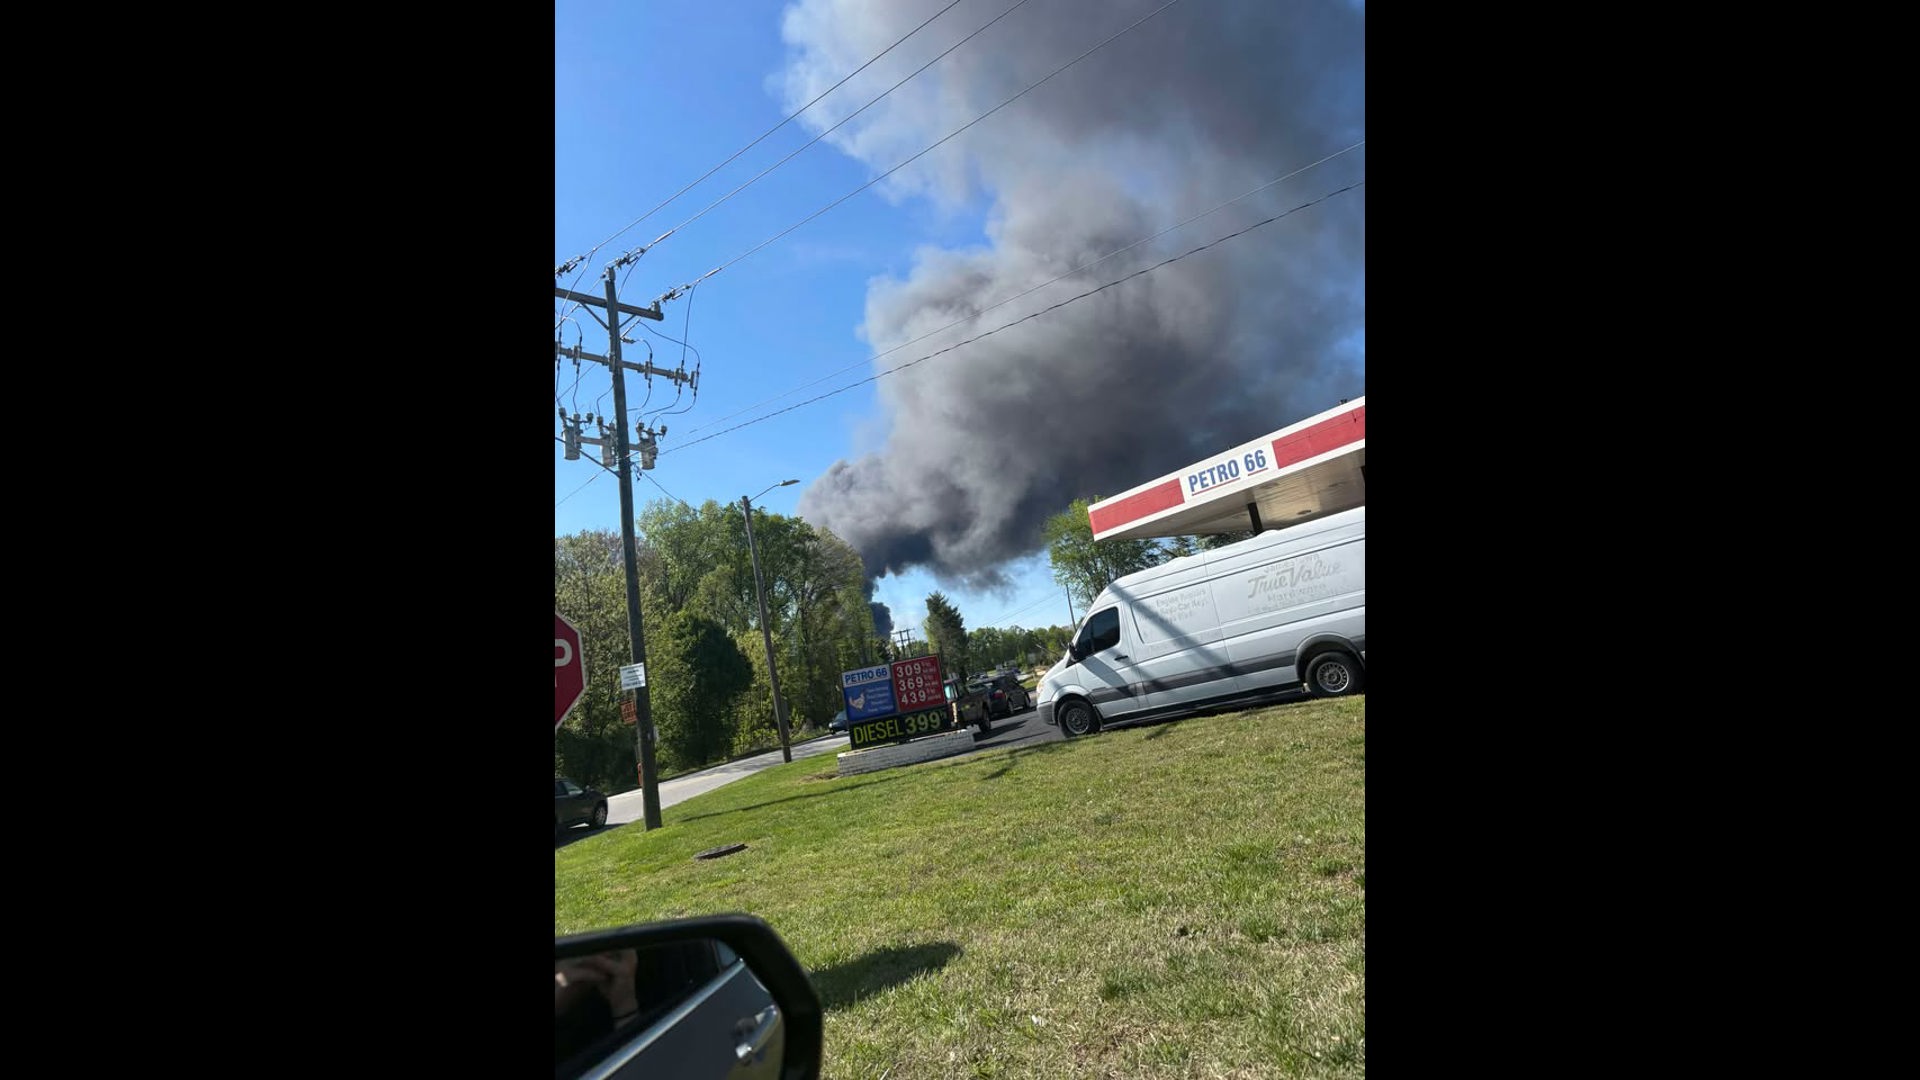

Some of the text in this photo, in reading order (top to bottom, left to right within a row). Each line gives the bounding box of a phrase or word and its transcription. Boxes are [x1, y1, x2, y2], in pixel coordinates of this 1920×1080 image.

[1188, 449, 1267, 493] PETRO 66
[1247, 560, 1341, 599] True Value
[844, 667, 888, 684] PETRO 66
[896, 662, 921, 678] 309
[898, 676, 924, 692] 369
[901, 690, 927, 704] 439
[854, 719, 904, 744] DIESEL
[904, 711, 941, 735] 399
